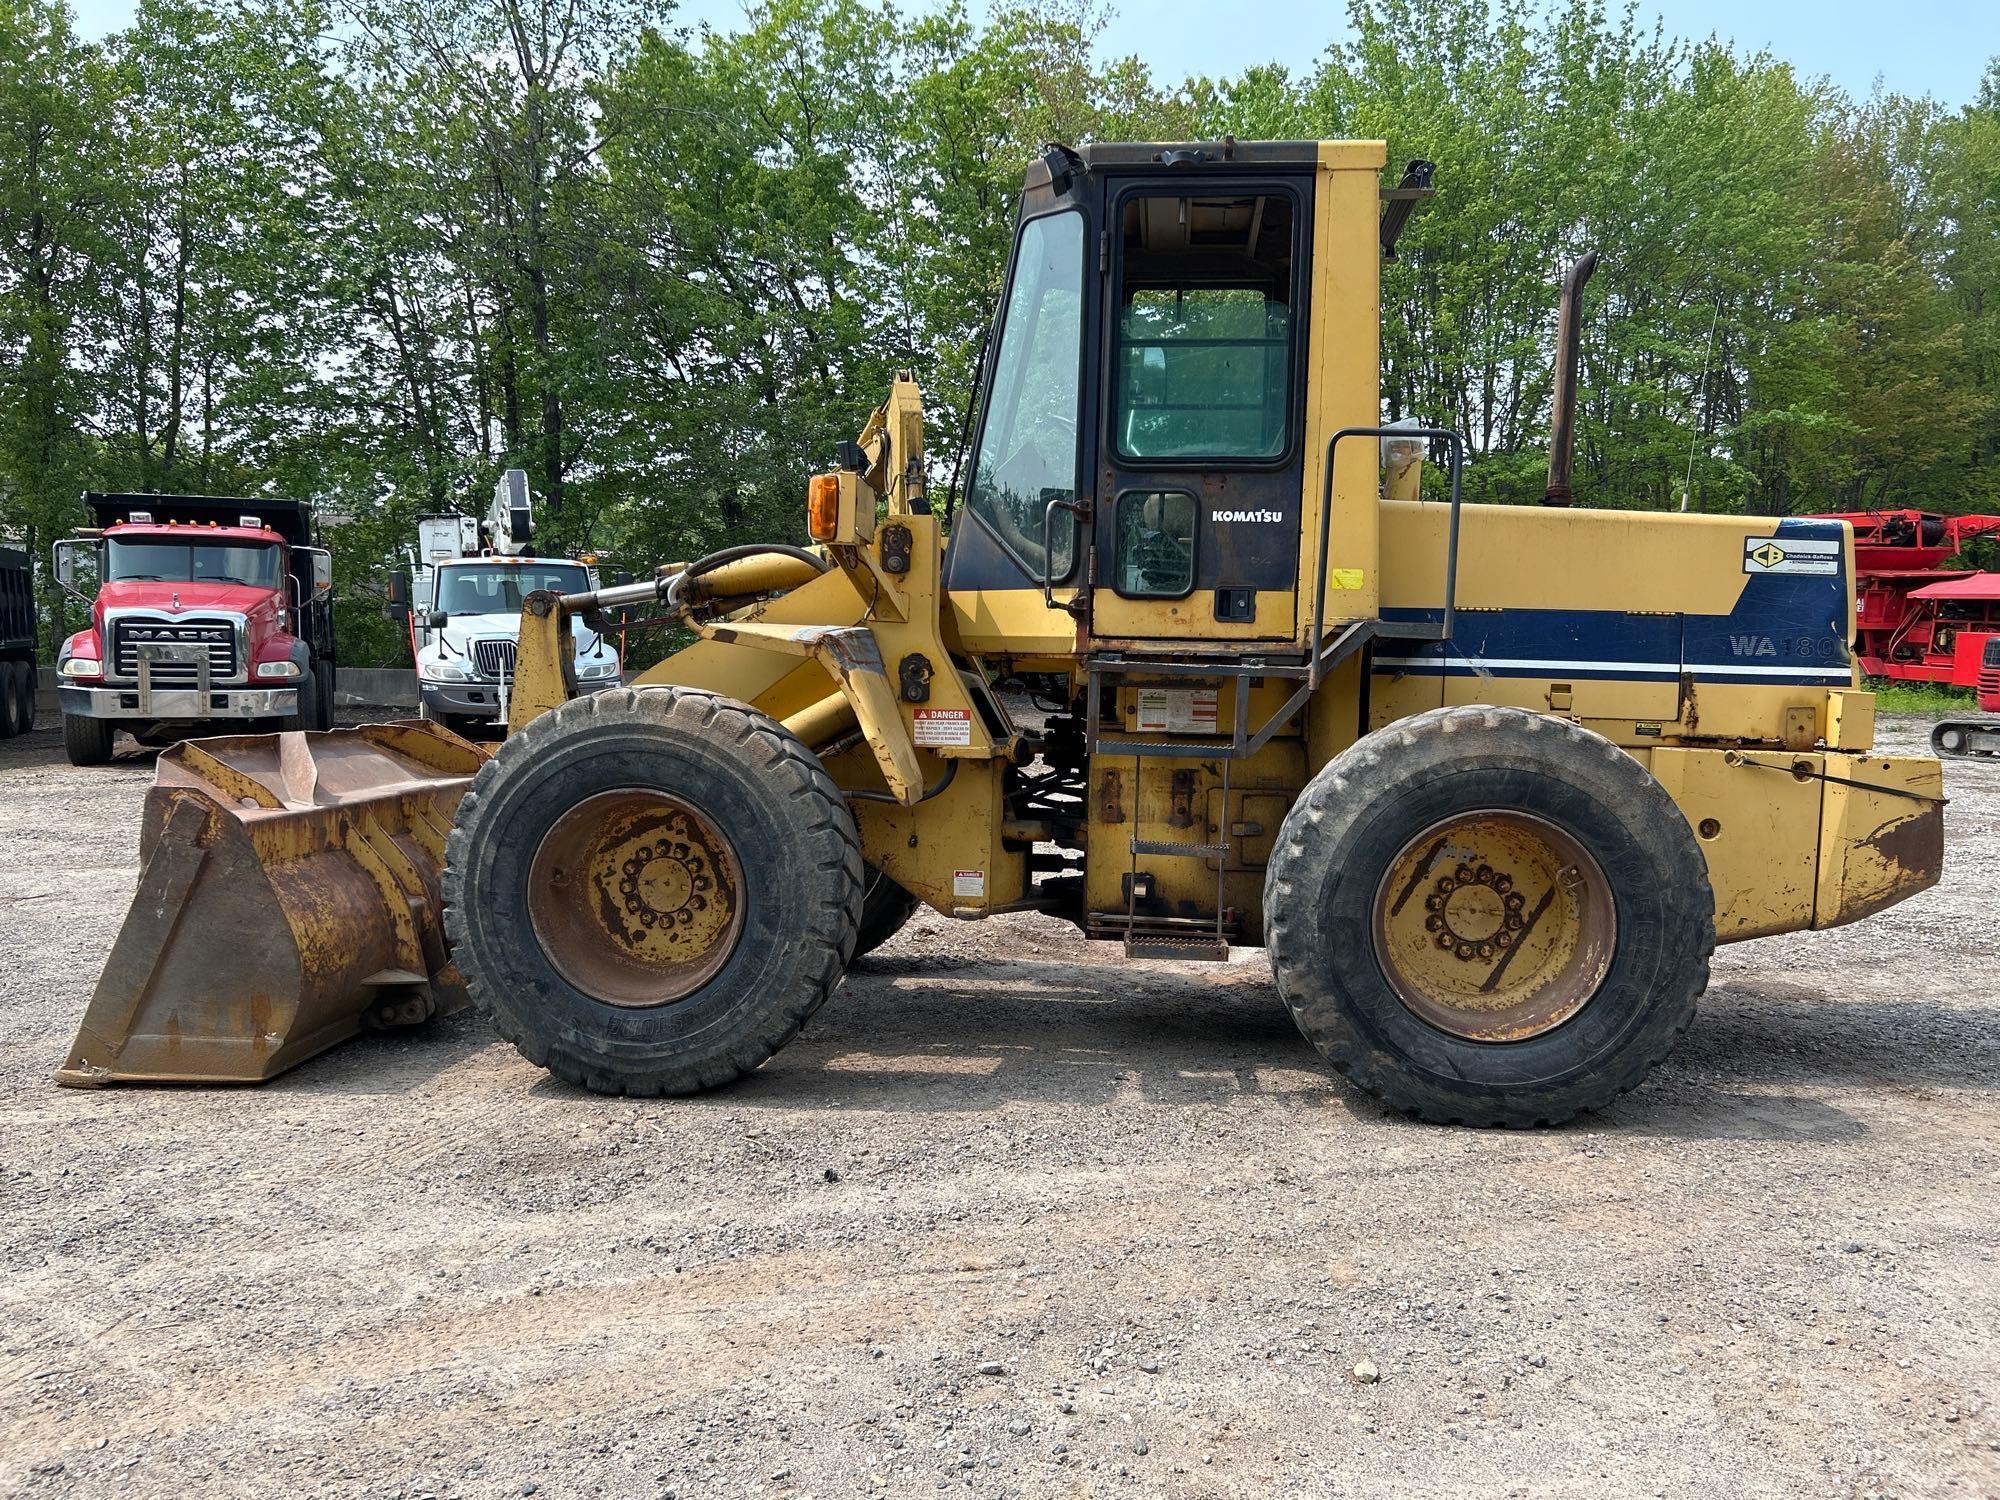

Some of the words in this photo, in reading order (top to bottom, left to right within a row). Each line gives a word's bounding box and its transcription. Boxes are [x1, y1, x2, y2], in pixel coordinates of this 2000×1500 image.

[1212, 508, 1283, 523] KOMATSU
[128, 630, 223, 640] MACK
[931, 710, 964, 719] DANGER
